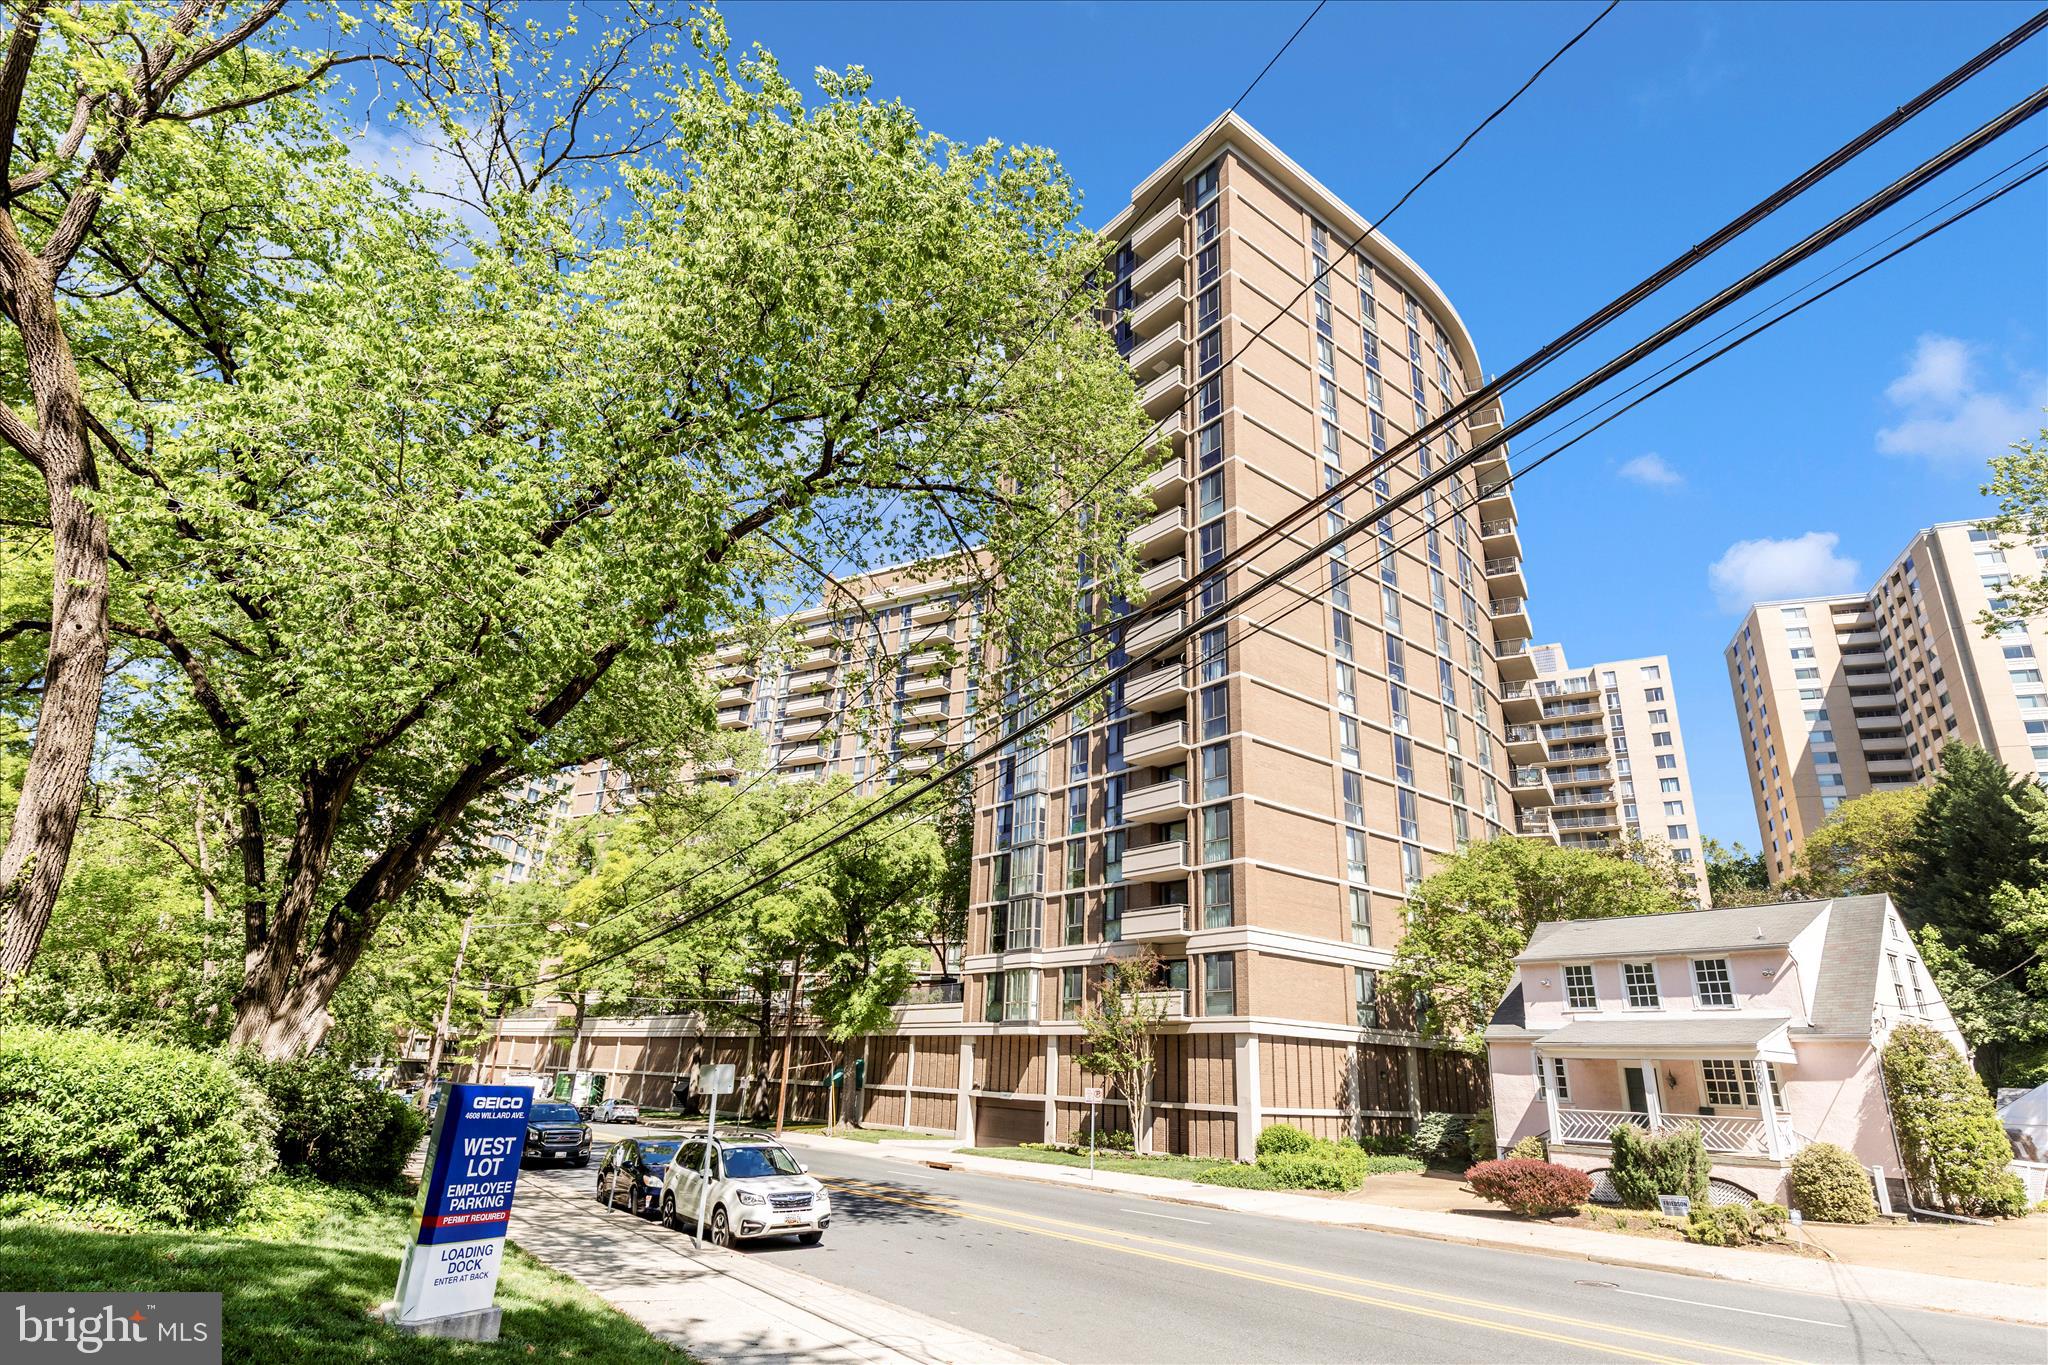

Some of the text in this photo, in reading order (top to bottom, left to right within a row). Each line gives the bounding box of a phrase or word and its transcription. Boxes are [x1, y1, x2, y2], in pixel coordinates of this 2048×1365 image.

[473, 1097, 523, 1109] GEICO
[464, 1137, 516, 1156] WEST
[467, 1158, 504, 1177] LOT
[447, 1181, 513, 1197] EMPLOYEE
[449, 1195, 504, 1211] PARKING
[442, 1212, 505, 1224] PERMIT REQUIRED
[441, 1244, 494, 1262] LOADING
[447, 1258, 483, 1274] DOCK
[434, 1271, 489, 1286] ENTER AT BACK
